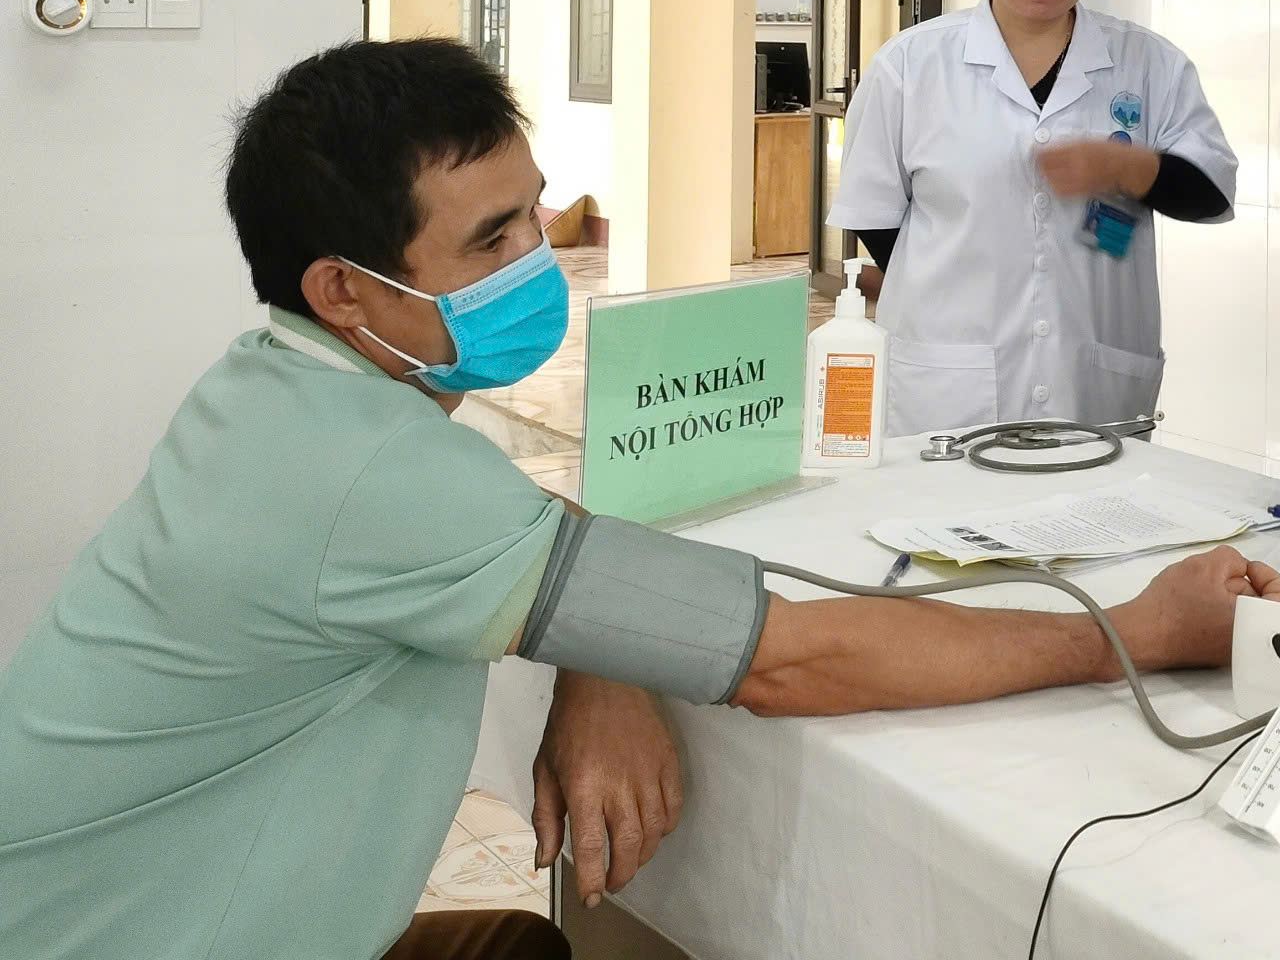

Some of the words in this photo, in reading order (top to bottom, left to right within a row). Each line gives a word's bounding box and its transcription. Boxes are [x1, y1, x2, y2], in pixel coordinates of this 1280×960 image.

[636, 374, 688, 409] BÀN
[693, 356, 766, 396] KHÁM
[608, 426, 656, 460] NỘI
[664, 410, 732, 446] TỔNG
[738, 396, 784, 428] HỢP
